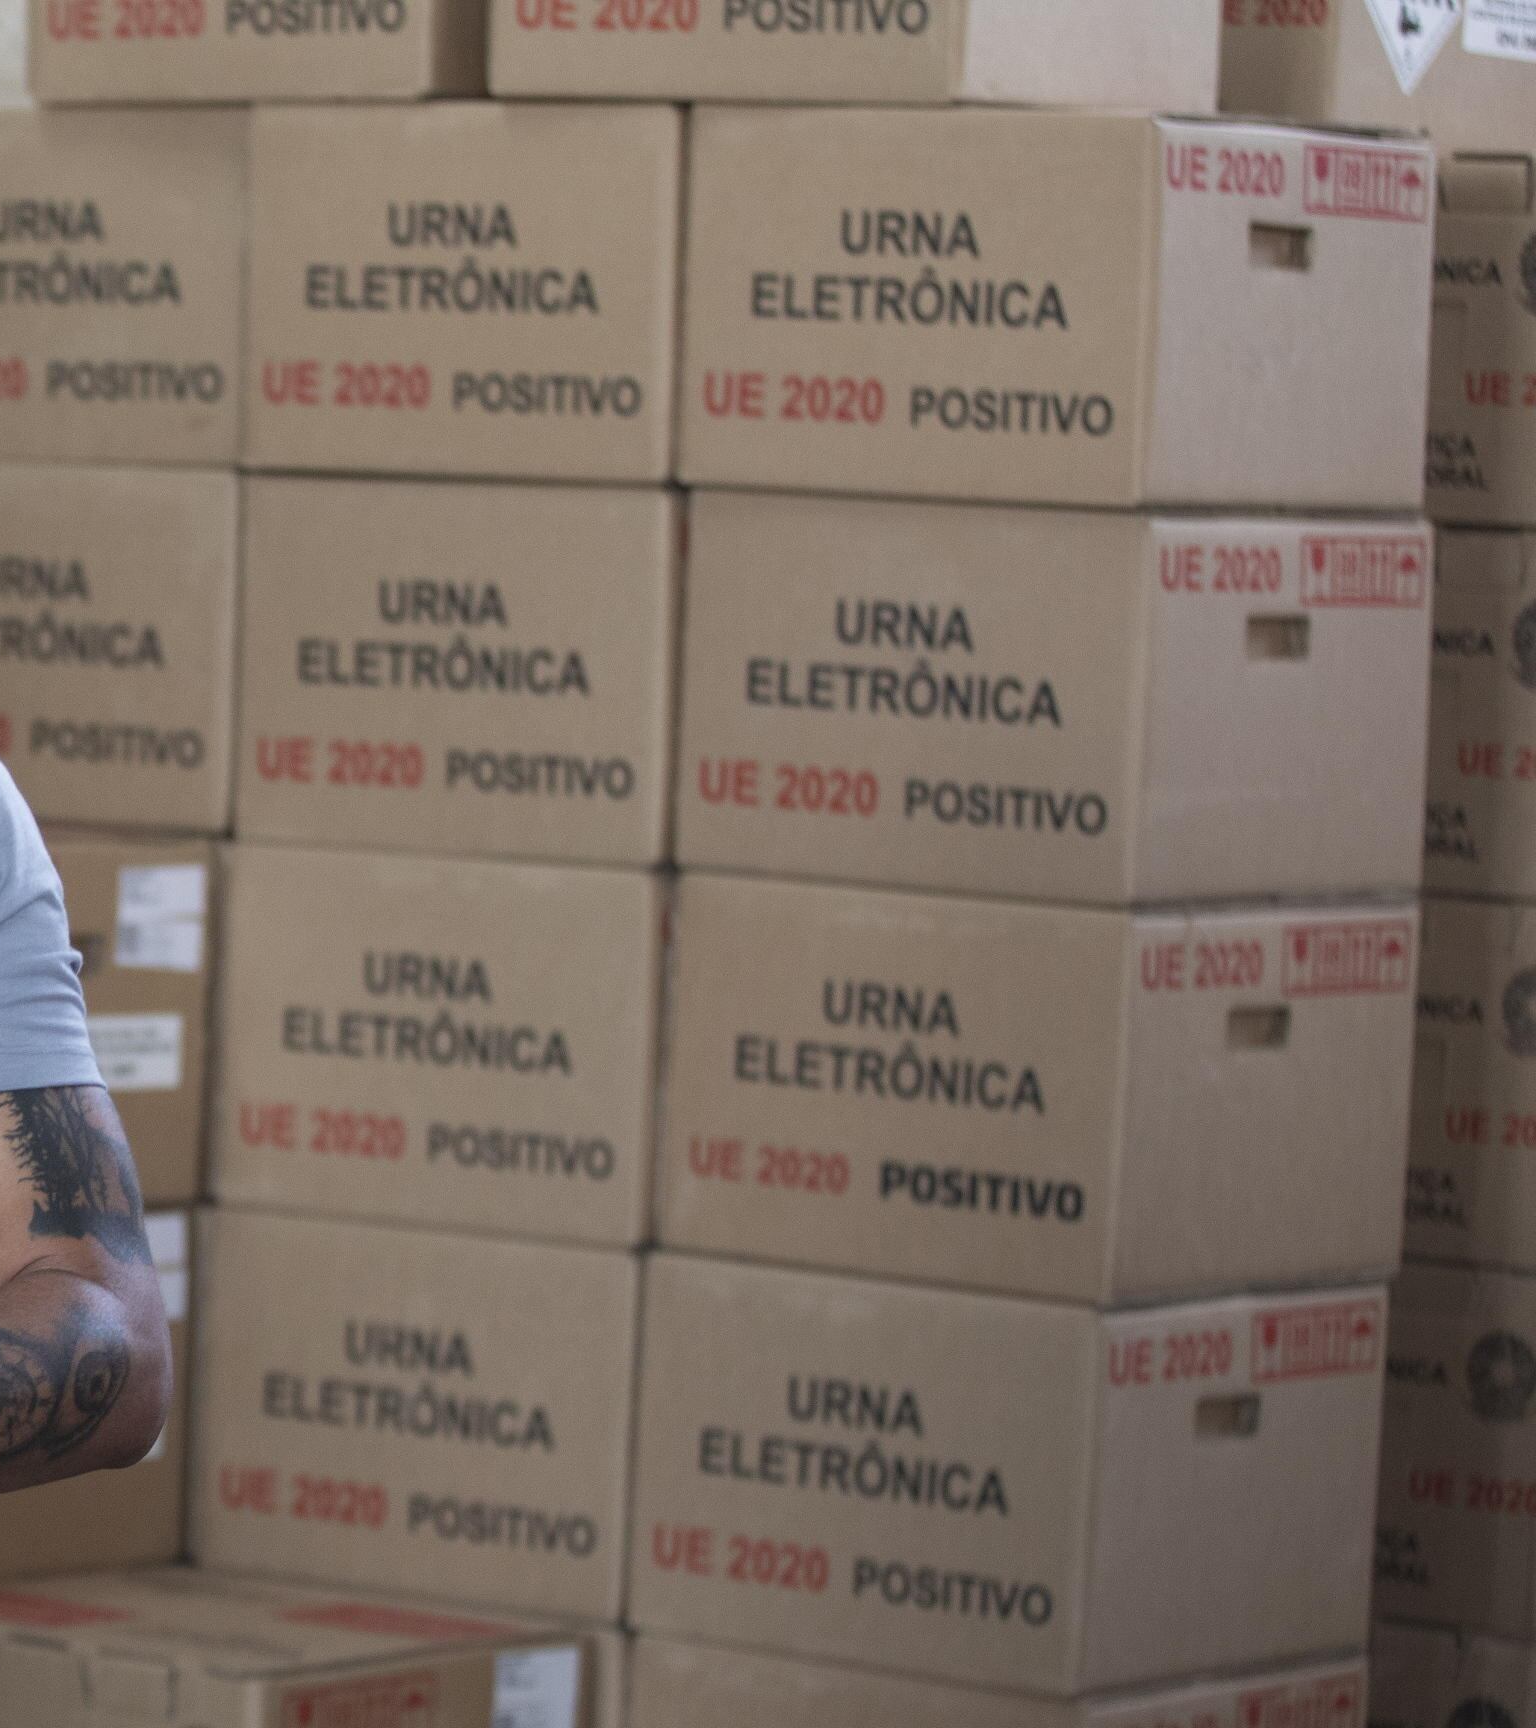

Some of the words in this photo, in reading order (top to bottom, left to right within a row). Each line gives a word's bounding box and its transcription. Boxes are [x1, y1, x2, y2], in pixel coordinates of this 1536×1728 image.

[48, 0, 101, 42] UE
[114, 0, 202, 40] 2020
[227, 0, 405, 36] POSITIVO
[516, 0, 576, 30] UE
[595, 0, 698, 33] 2020
[724, 0, 929, 36] POSITIVO
[1168, 146, 1209, 192] UE
[1217, 148, 1286, 197] 2020
[388, 203, 517, 247] URNA
[841, 210, 980, 258] URNA
[305, 256, 599, 315] ELETRÔNICA
[751, 266, 1067, 329] ELETRÔNICA
[46, 361, 224, 403] POSITIVO
[263, 359, 320, 406] UE
[334, 362, 431, 410] 2020
[453, 372, 643, 418] POSITIVO
[703, 371, 765, 420] UE
[781, 374, 886, 424] 2020
[910, 387, 1114, 437] POSITIVO
[1159, 545, 1203, 592] UE
[1212, 546, 1281, 592] 2020
[379, 580, 507, 627] URNA
[836, 600, 973, 652] URNA
[298, 634, 590, 696] ELETRÔNICA
[746, 658, 1062, 728] ELETRÔNICA
[29, 718, 206, 770] POSITIVO
[257, 736, 313, 783] UE
[327, 741, 425, 789] 2020
[445, 749, 635, 801] POSITIVO
[698, 760, 758, 807] UE
[775, 764, 878, 817] 2020
[904, 778, 1108, 836] POSITIVO
[364, 952, 491, 1002] URNA
[1140, 944, 1184, 991] UE
[1194, 938, 1264, 990] 2020
[823, 981, 959, 1037] URNA
[282, 1006, 572, 1075] ELETRÔNICA
[734, 1034, 1045, 1115] ELETRÔNICA
[240, 1104, 294, 1150] UE
[311, 1109, 406, 1160] 2020
[426, 1123, 615, 1181] POSITIVO
[689, 1137, 743, 1183] UE
[755, 1145, 850, 1196] 2020
[879, 1160, 1084, 1222] POSITIVO
[345, 1322, 473, 1376] URNA
[1108, 1338, 1153, 1386] UE
[1161, 1329, 1233, 1382] 2020
[262, 1371, 555, 1452] ELETRÔNICA
[788, 1377, 923, 1437] URNA
[698, 1426, 1009, 1516] ELETRÔNICA
[221, 1468, 278, 1512] UE
[292, 1474, 387, 1529] 2020
[407, 1492, 598, 1558] POSITIVO
[652, 1524, 711, 1575] UE
[727, 1536, 830, 1593] 2020
[852, 1557, 1053, 1627] POSITIVO
